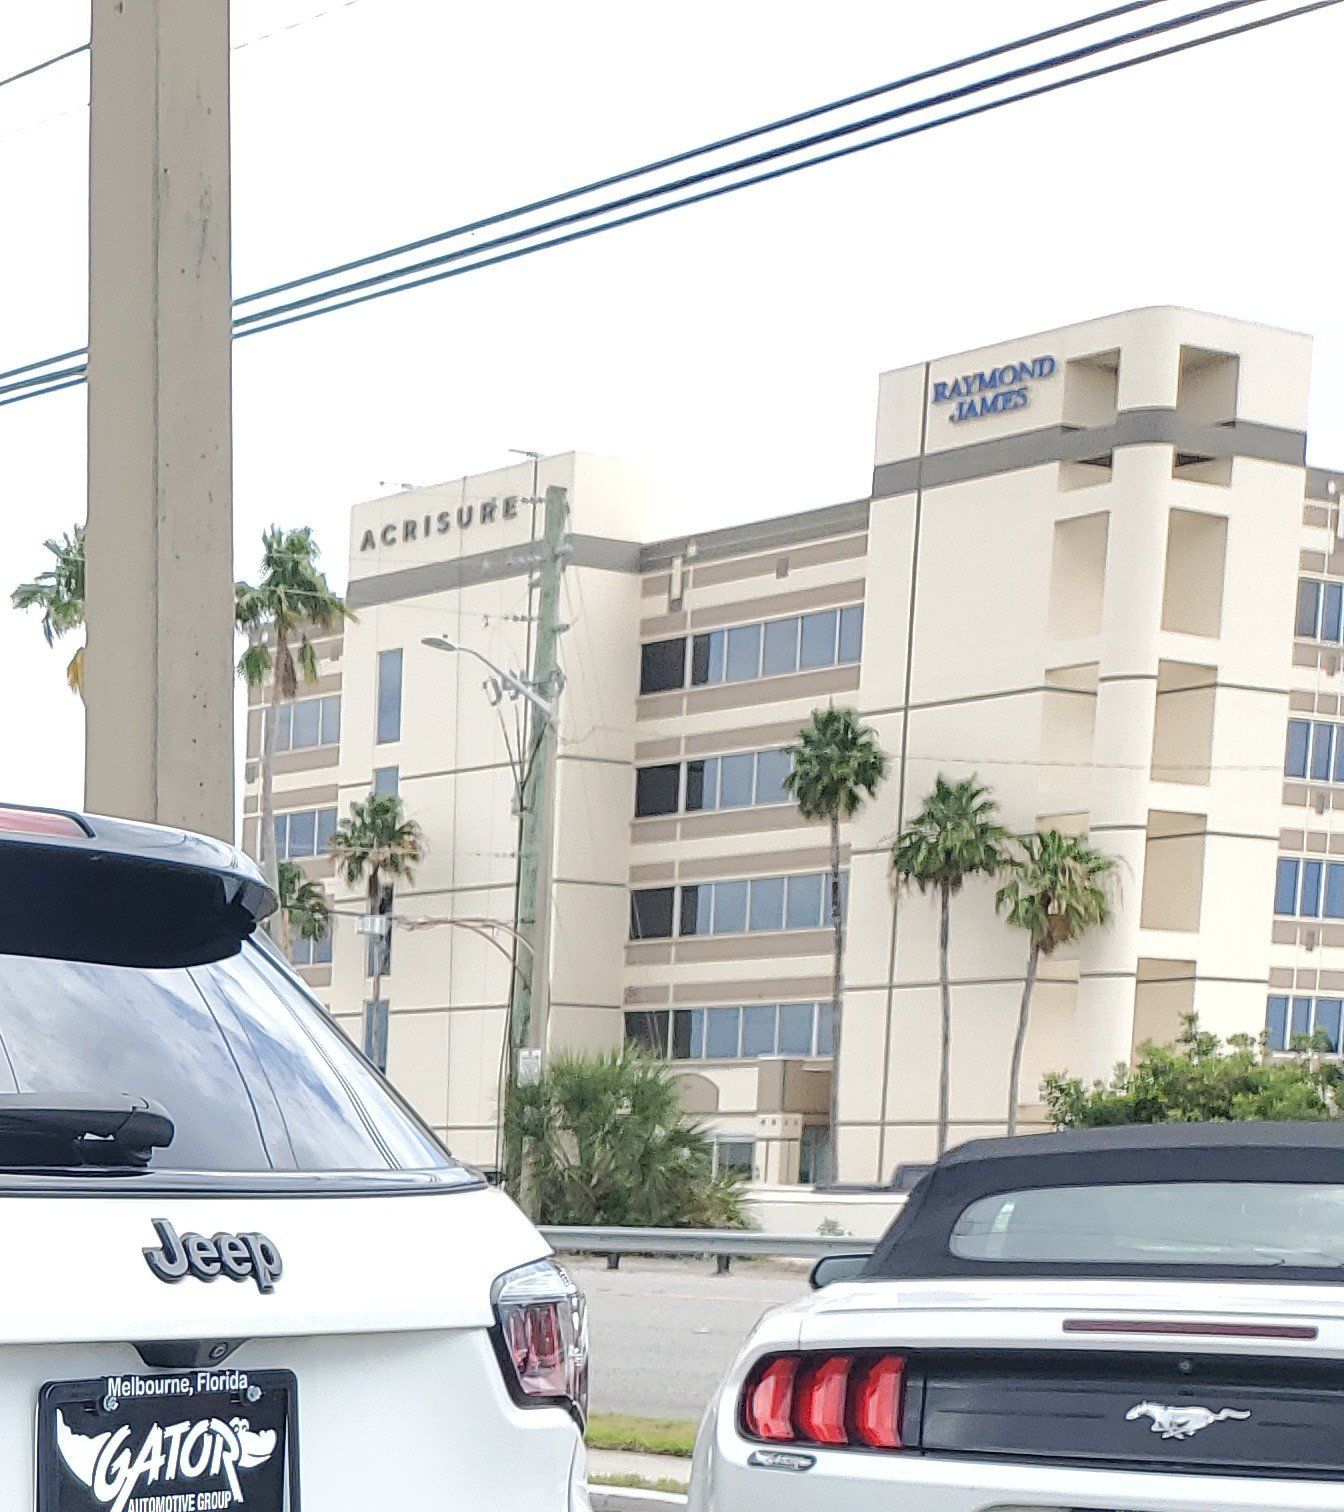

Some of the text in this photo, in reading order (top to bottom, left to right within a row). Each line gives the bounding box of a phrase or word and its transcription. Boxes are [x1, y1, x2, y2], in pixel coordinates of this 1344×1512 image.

[933, 355, 1055, 403] RAYMOND
[949, 386, 1028, 421] JAMES
[361, 496, 518, 551] ACRISURE
[142, 1218, 283, 1294] Jeep
[107, 1371, 248, 1397] Melbourne, Florida
[197, 1491, 232, 1509] GROUP
